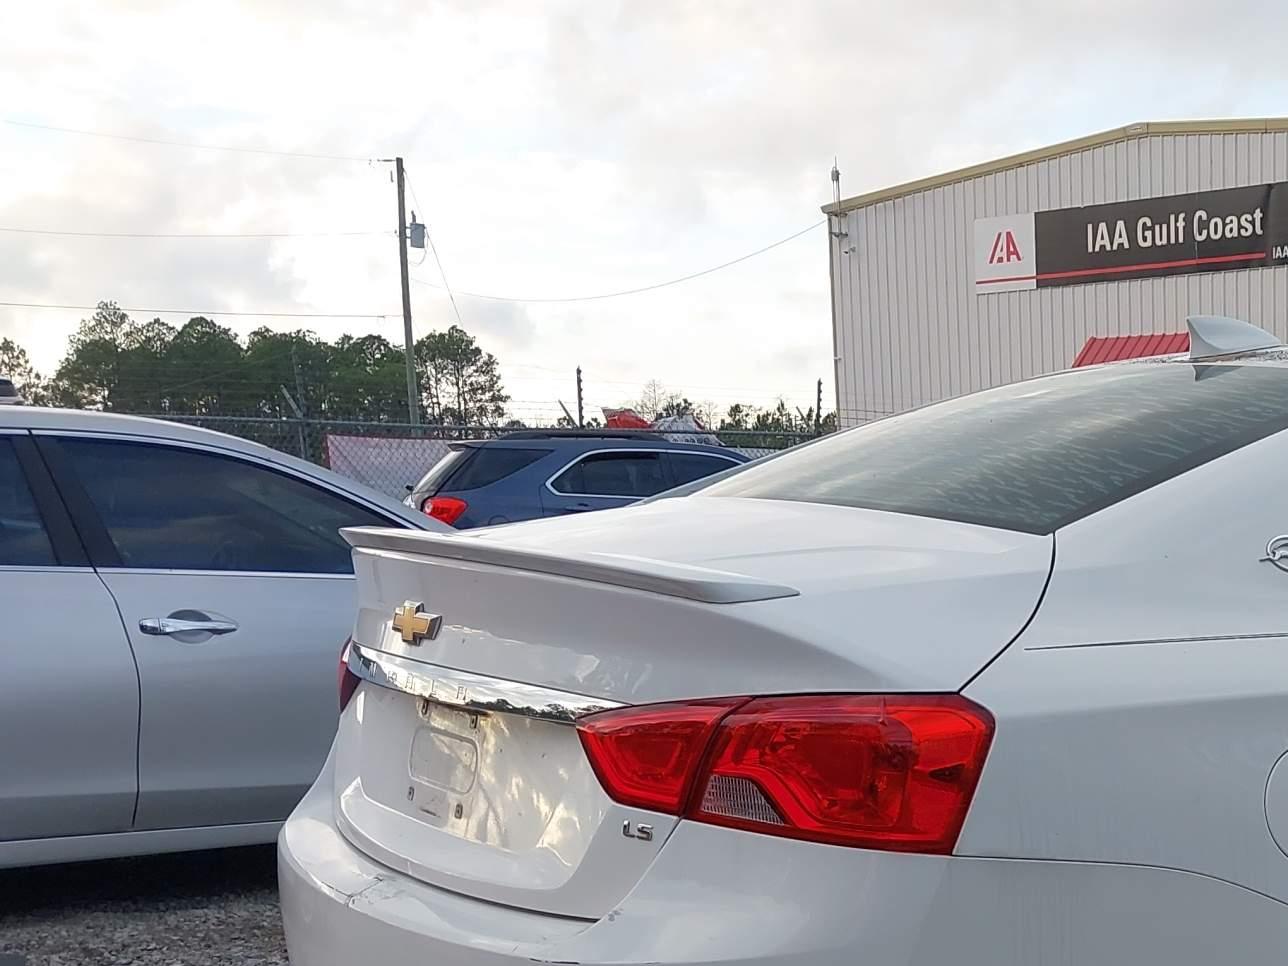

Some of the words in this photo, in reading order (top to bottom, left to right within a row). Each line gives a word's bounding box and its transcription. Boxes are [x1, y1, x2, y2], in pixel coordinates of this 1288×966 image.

[1087, 220, 1130, 253] IAA
[1136, 212, 1186, 248] Gulf
[1193, 206, 1264, 242] Coast
[622, 820, 653, 841] LS
